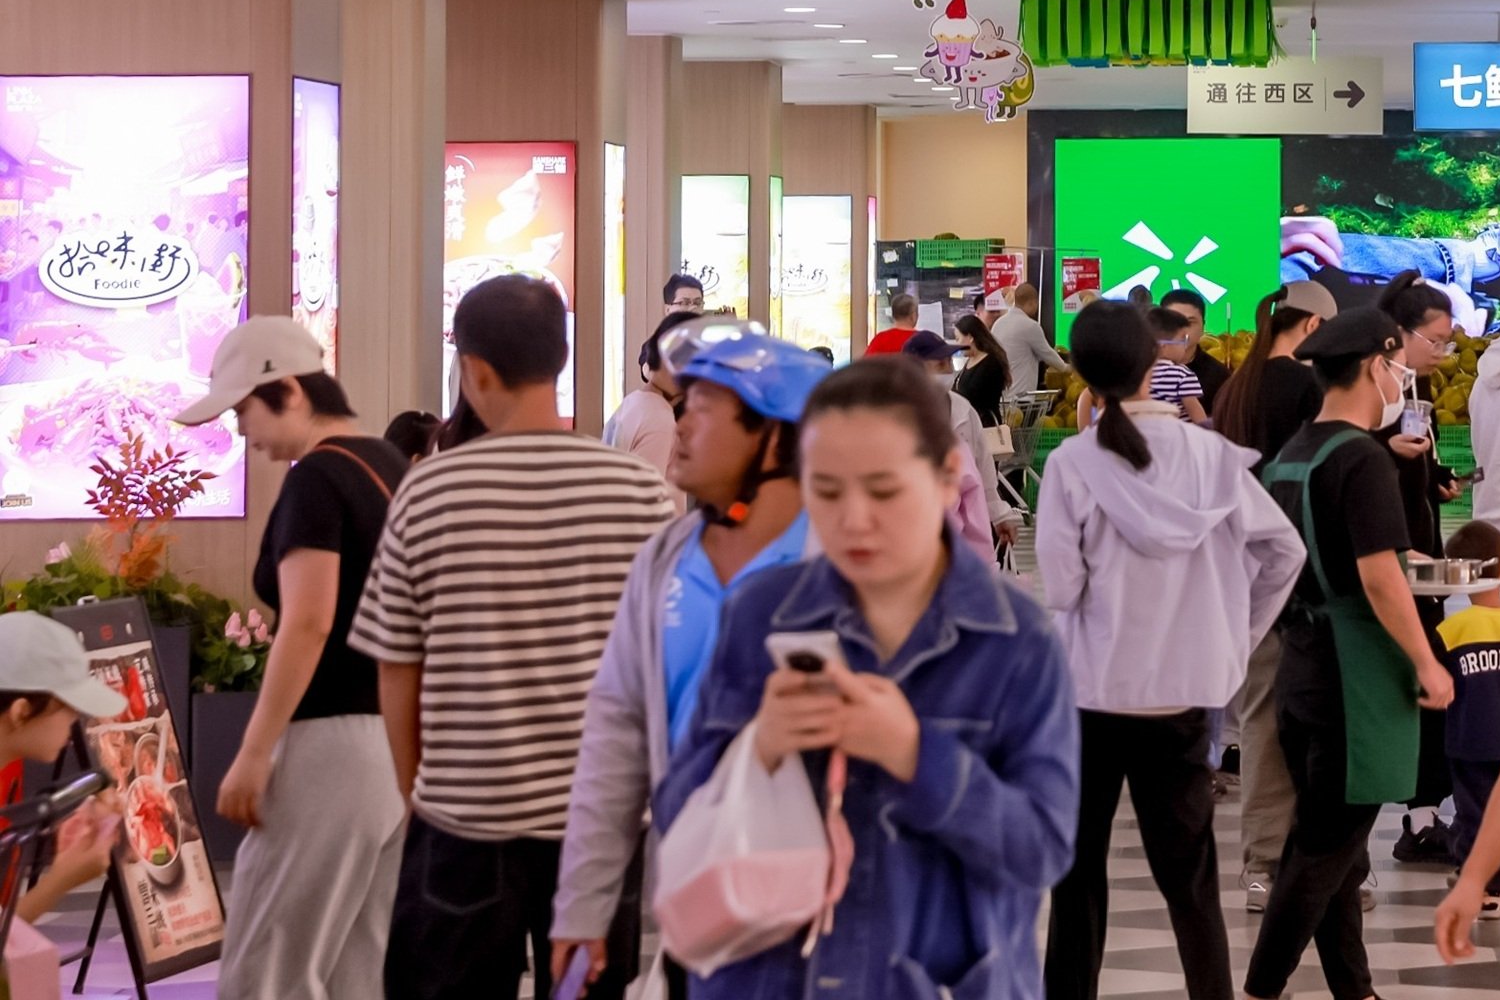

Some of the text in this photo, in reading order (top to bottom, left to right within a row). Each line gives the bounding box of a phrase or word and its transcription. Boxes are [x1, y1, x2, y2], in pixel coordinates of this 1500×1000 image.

[1206, 82, 1314, 104] 通往西区
[94, 278, 141, 290] Foodie
